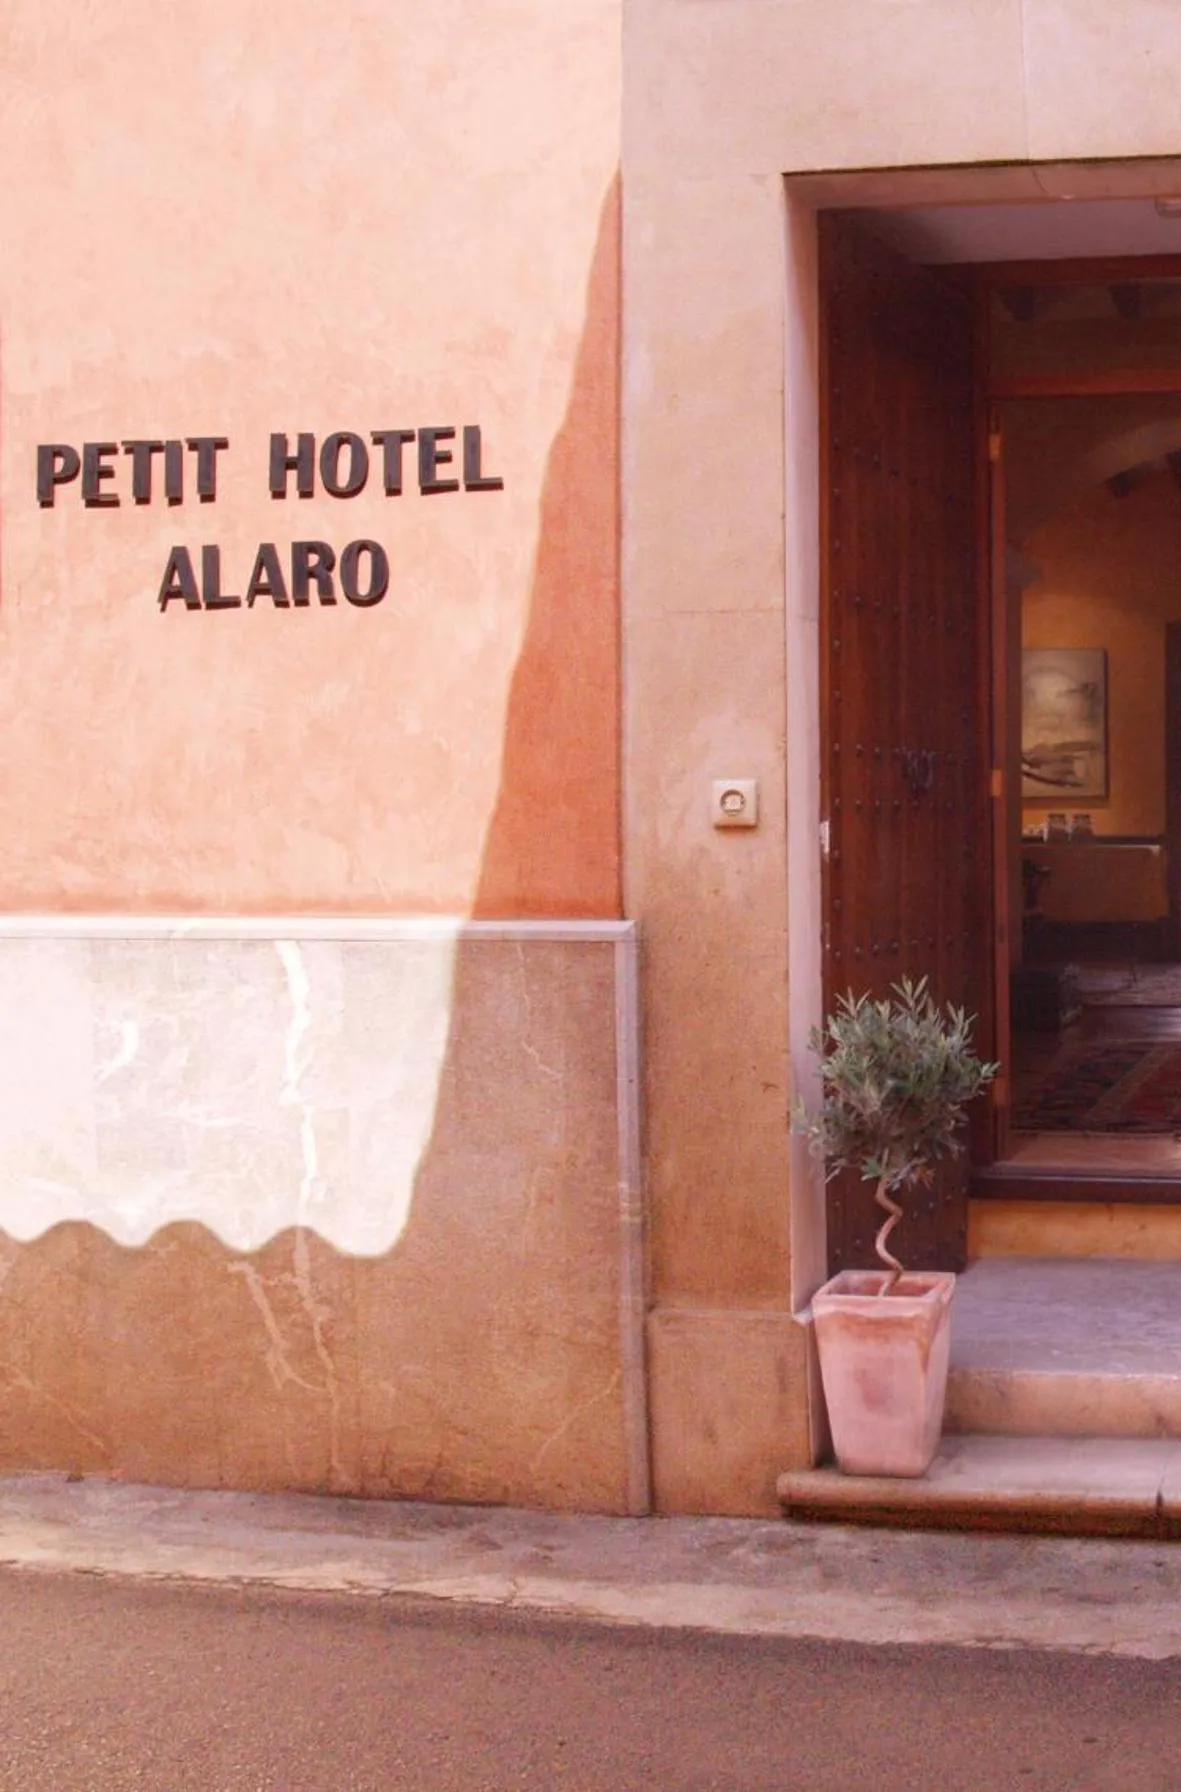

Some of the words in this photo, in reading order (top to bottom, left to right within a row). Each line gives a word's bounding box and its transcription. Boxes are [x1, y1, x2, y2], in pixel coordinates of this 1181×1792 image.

[37, 437, 228, 508] PETIT
[269, 425, 504, 499] HOTEL
[158, 539, 389, 612] ALARO
